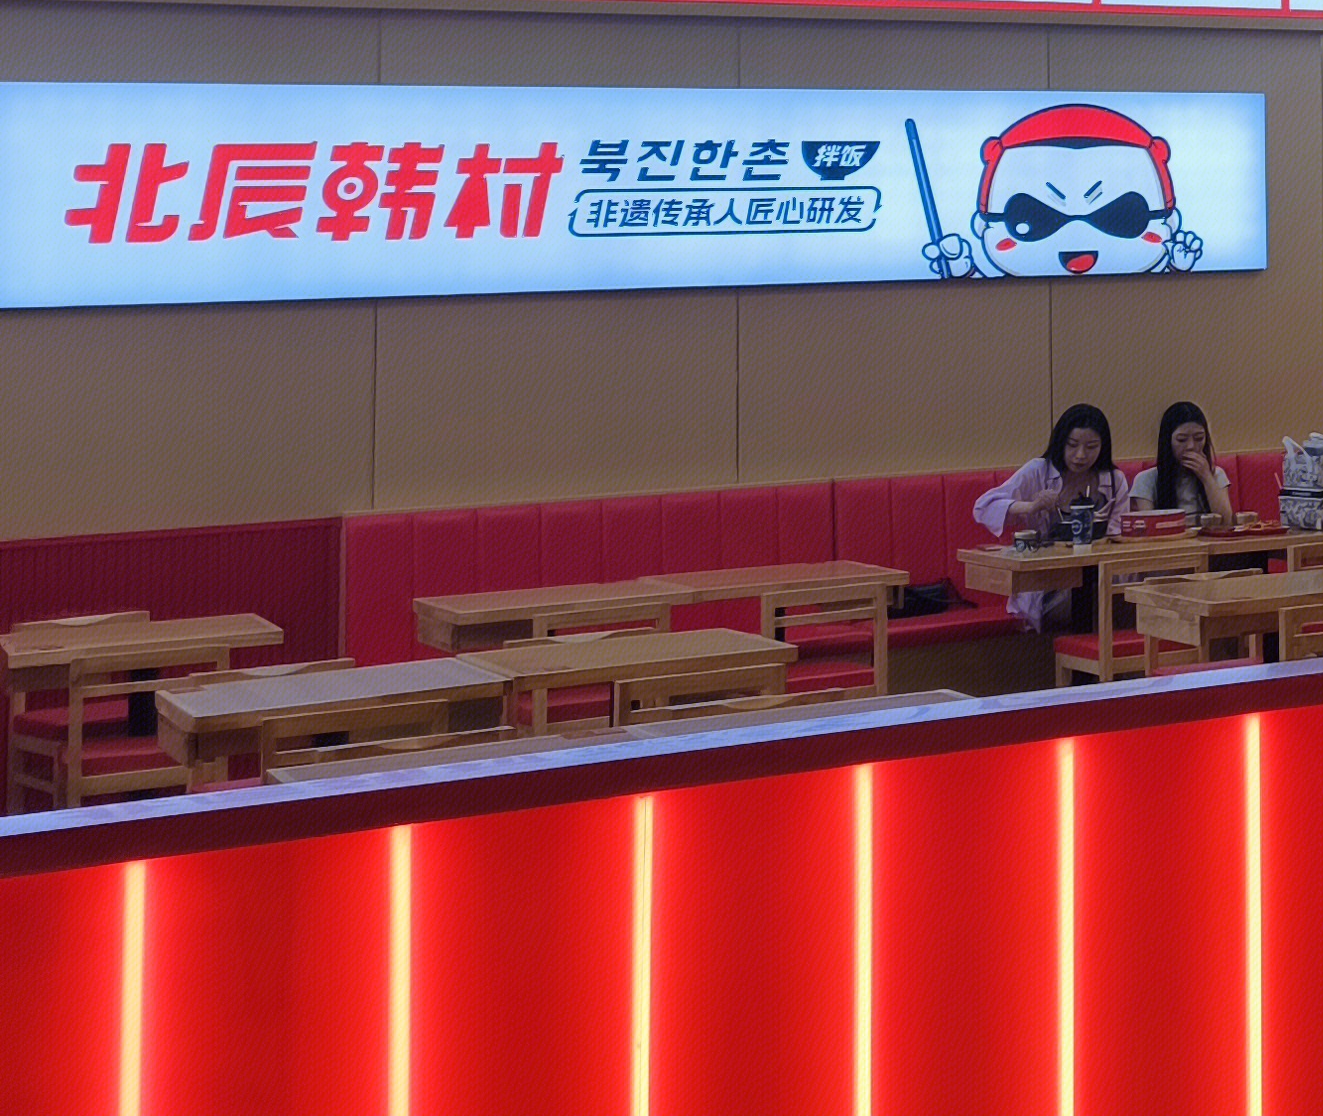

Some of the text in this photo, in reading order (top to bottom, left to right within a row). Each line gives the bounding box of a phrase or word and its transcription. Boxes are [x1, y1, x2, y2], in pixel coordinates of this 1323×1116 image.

[579, 138, 791, 182] 북진한촌
[811, 143, 867, 168] 拌饭
[63, 139, 565, 245] 北辰韩村
[585, 195, 866, 228] 非遗传承人匠心研发
